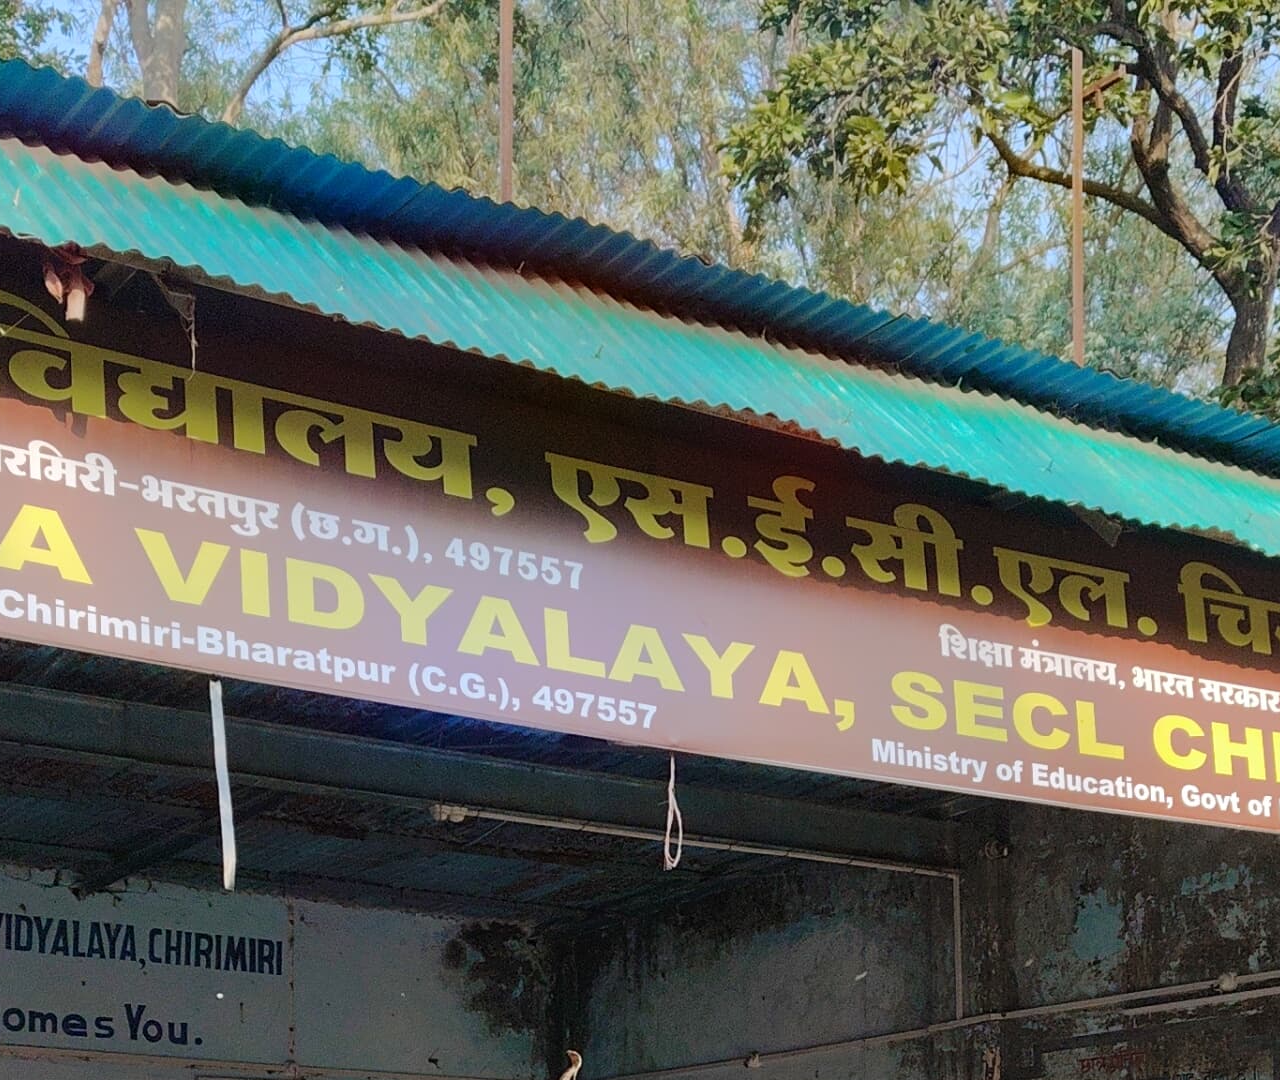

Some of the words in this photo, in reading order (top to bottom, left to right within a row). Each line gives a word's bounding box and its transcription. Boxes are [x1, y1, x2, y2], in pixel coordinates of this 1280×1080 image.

[445, 540, 584, 592] 497557
[545, 450, 1159, 637] एस.ई.सी.एल.
[134, 527, 855, 732] VIDYALAYA,
[890, 670, 1125, 761] SECL
[938, 623, 1013, 669] शिक्षा
[1020, 639, 1125, 691] मंत्रालय,
[1132, 666, 1194, 699] भारत
[409, 665, 522, 712] (C.G.),
[531, 686, 658, 731] 497557
[871, 738, 988, 784] Ministry
[996, 759, 1023, 784] of
[1032, 764, 1174, 810] Education,
[1181, 785, 1241, 814] Govt
[1247, 796, 1273, 819] of
[124, 1003, 203, 1046] You.
